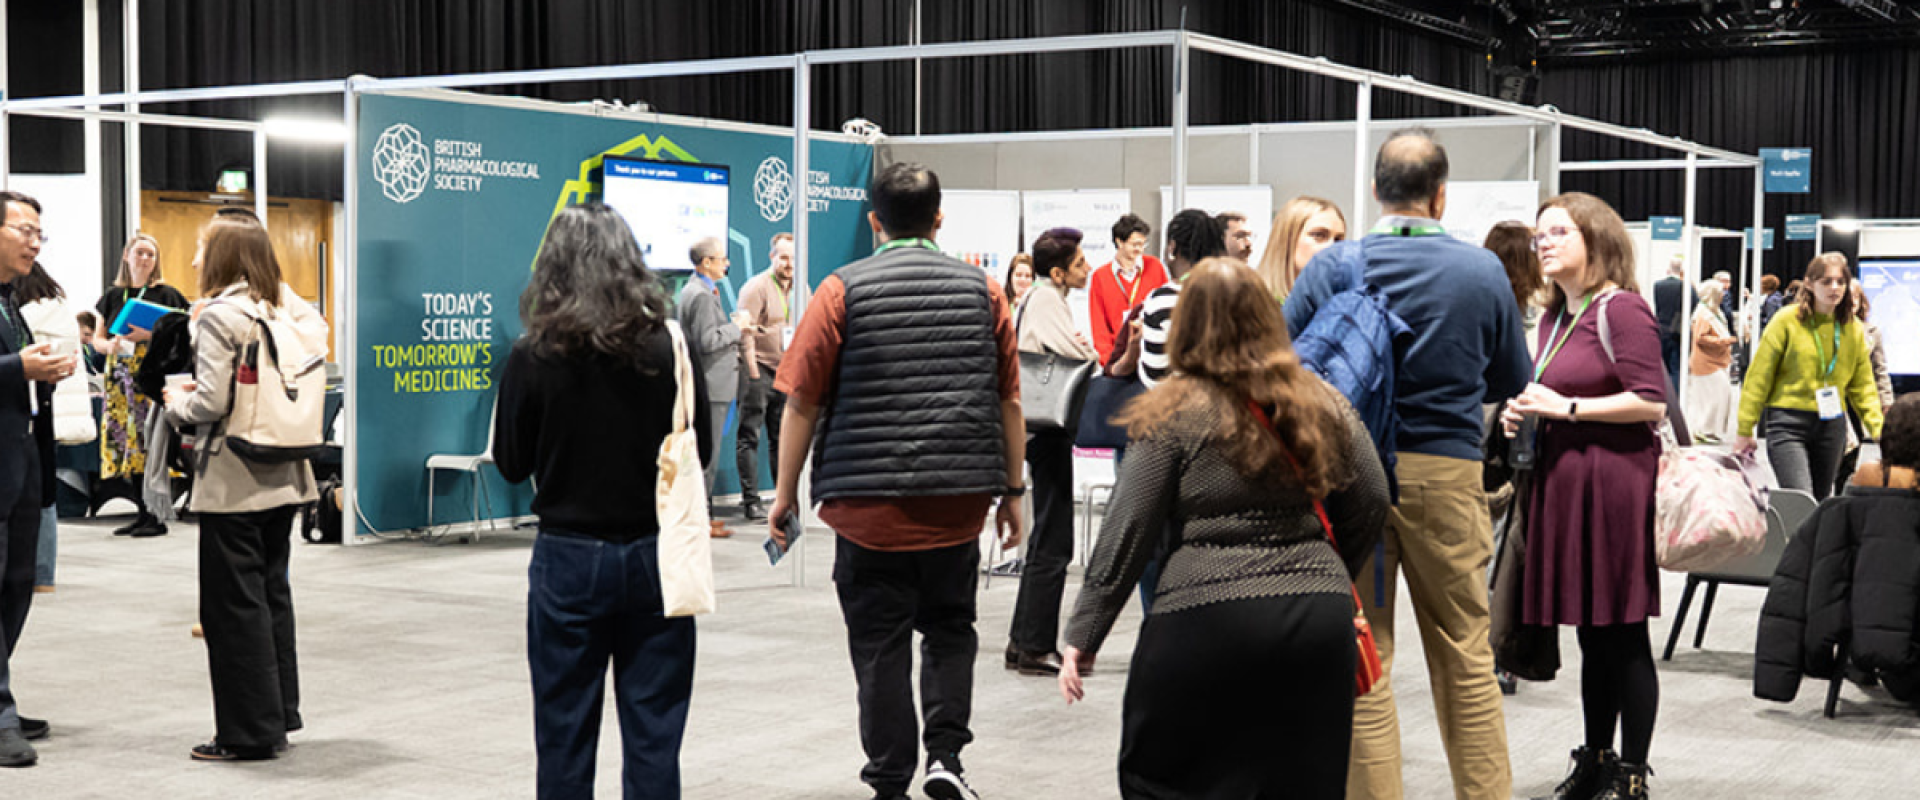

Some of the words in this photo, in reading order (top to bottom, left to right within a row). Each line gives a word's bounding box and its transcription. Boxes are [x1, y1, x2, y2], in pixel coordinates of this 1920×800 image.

[434, 138, 482, 157] BRITISH
[434, 156, 541, 179] PHARMACOLOGICAL
[434, 173, 482, 192] SOCIETY
[422, 291, 492, 315] TODAY'S
[422, 318, 492, 341] SCIENCE
[371, 342, 492, 368] TOMORROW'S
[393, 367, 492, 393] MEDICINES
